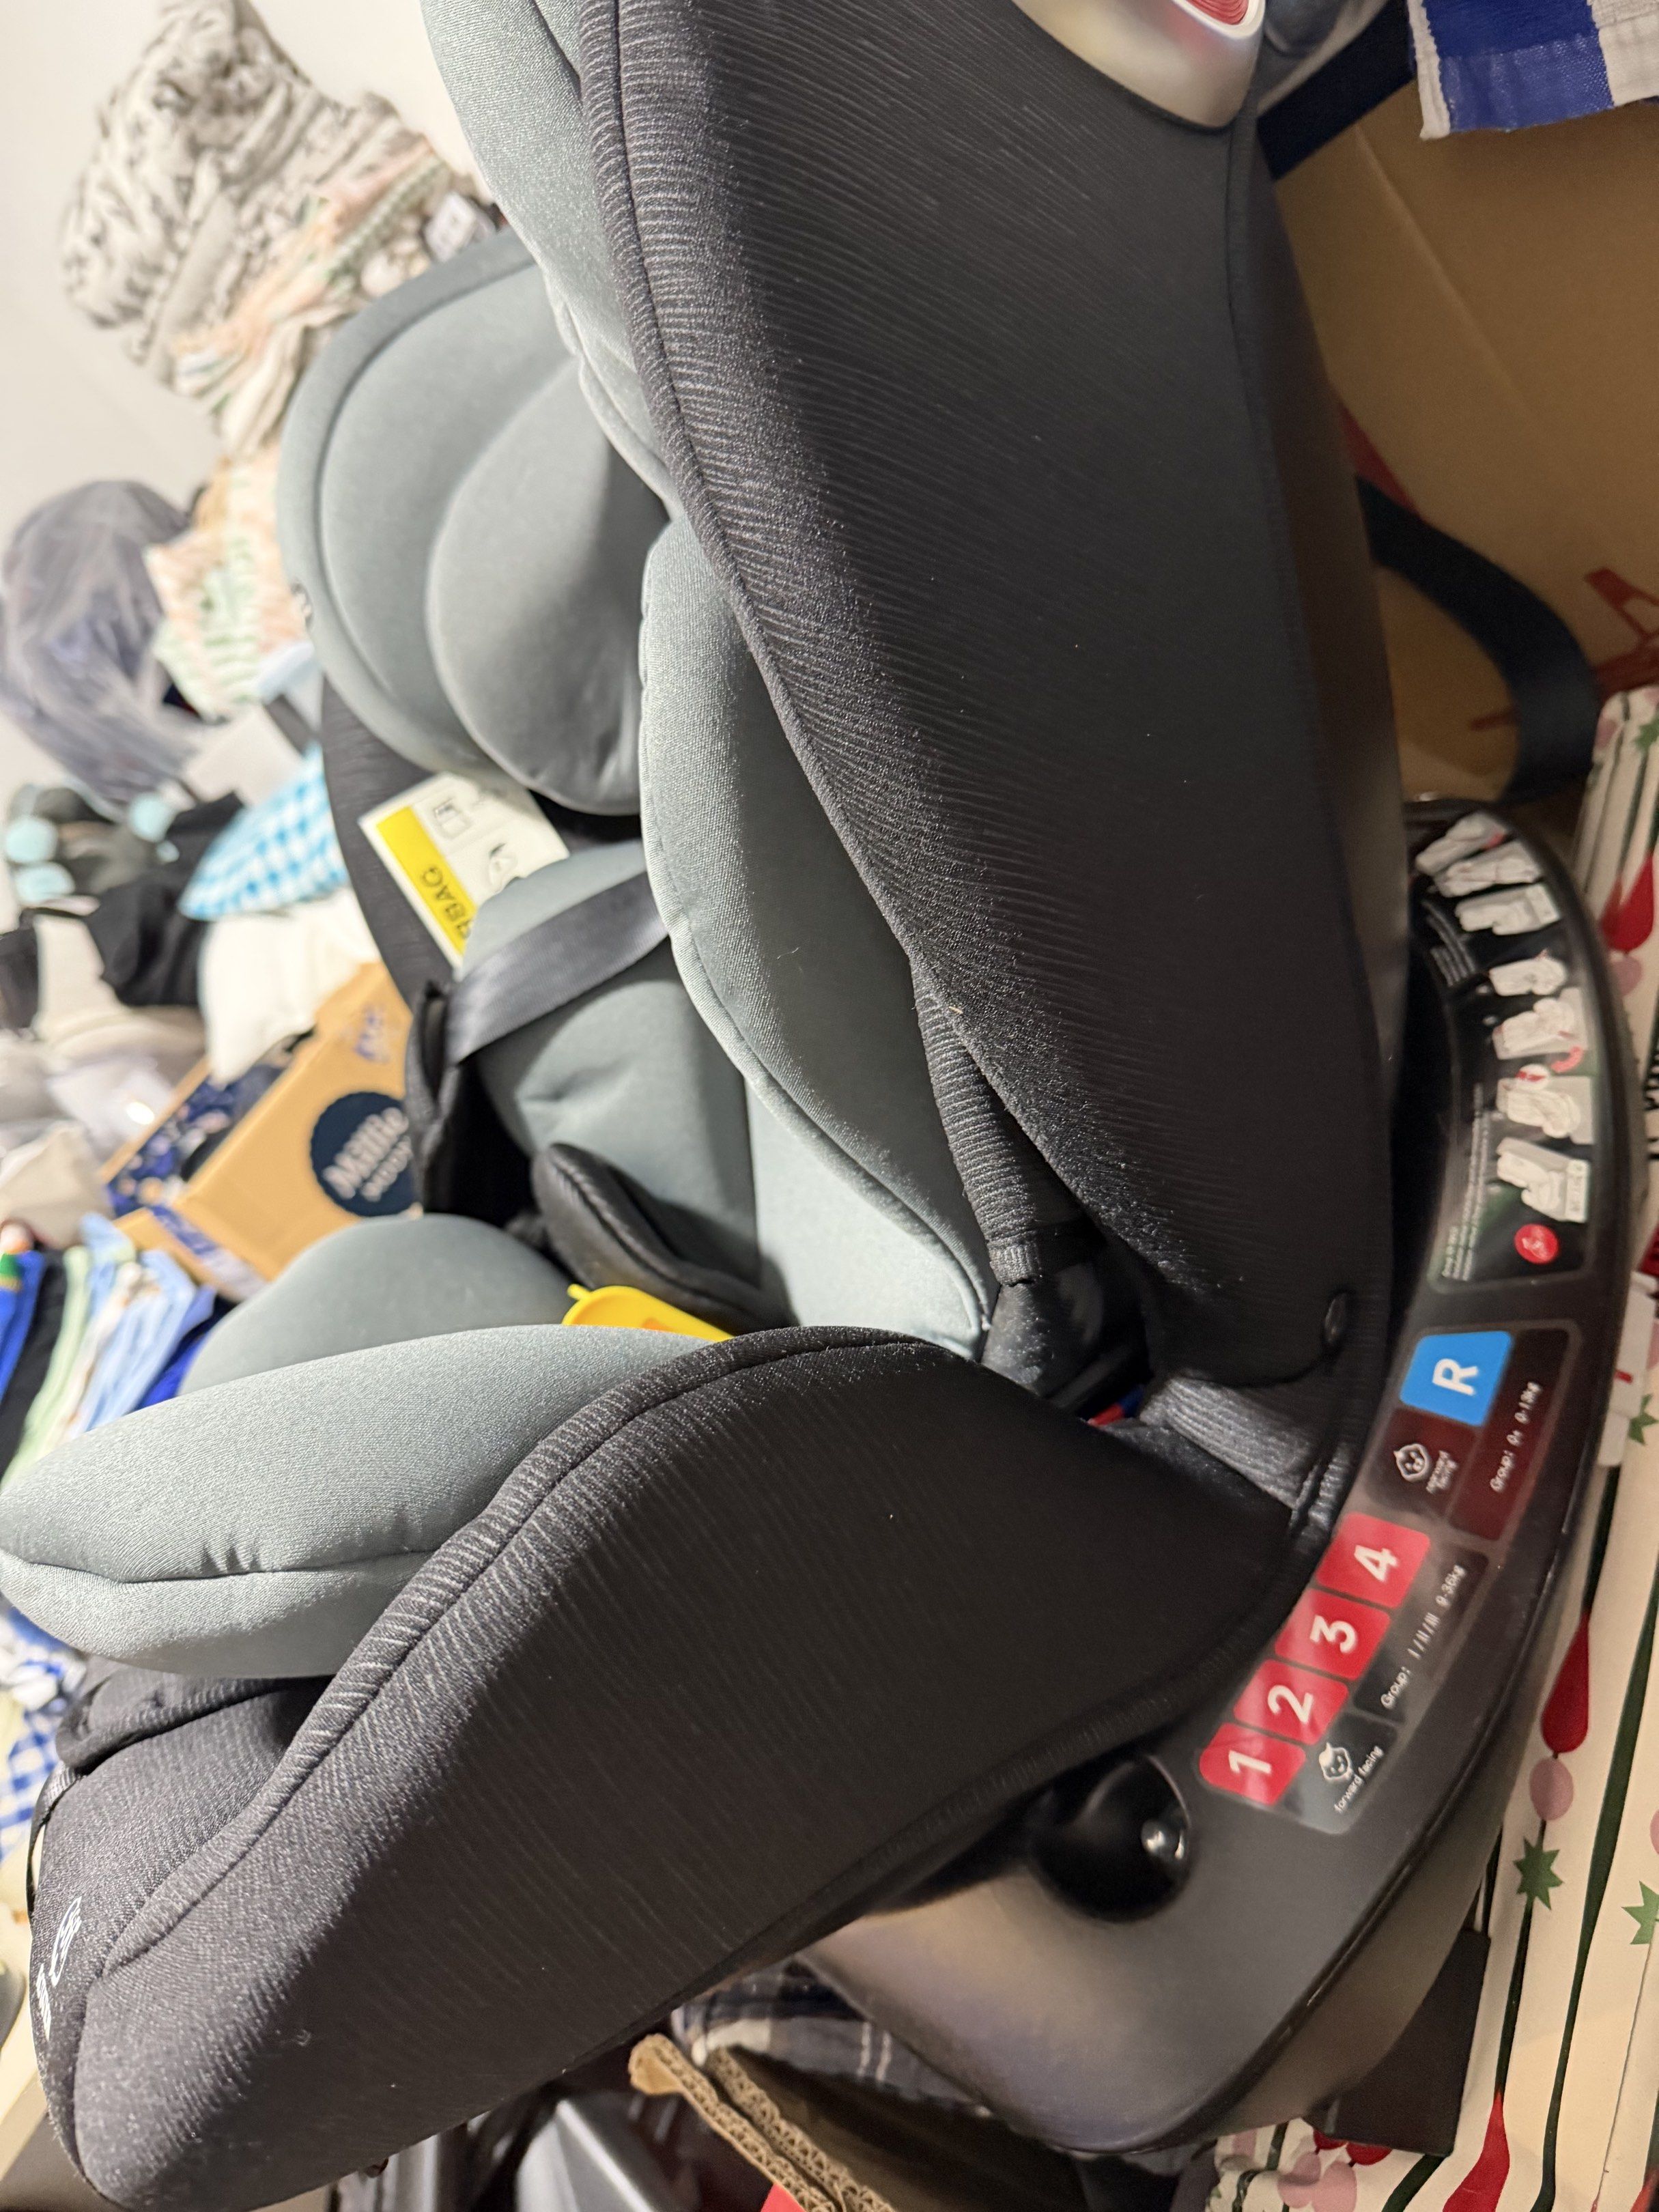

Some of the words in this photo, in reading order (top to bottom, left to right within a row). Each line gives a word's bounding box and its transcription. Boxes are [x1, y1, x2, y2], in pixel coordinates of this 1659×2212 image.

[1432, 1358, 1479, 1397] R
[1228, 1748, 1273, 1775] 1
[1267, 1684, 1314, 1725] 2
[1309, 1614, 1359, 1654] 3
[1353, 1544, 1400, 1583] 4
[1380, 1666, 1411, 1710] Group:
[1334, 1774, 1365, 1815] forward
